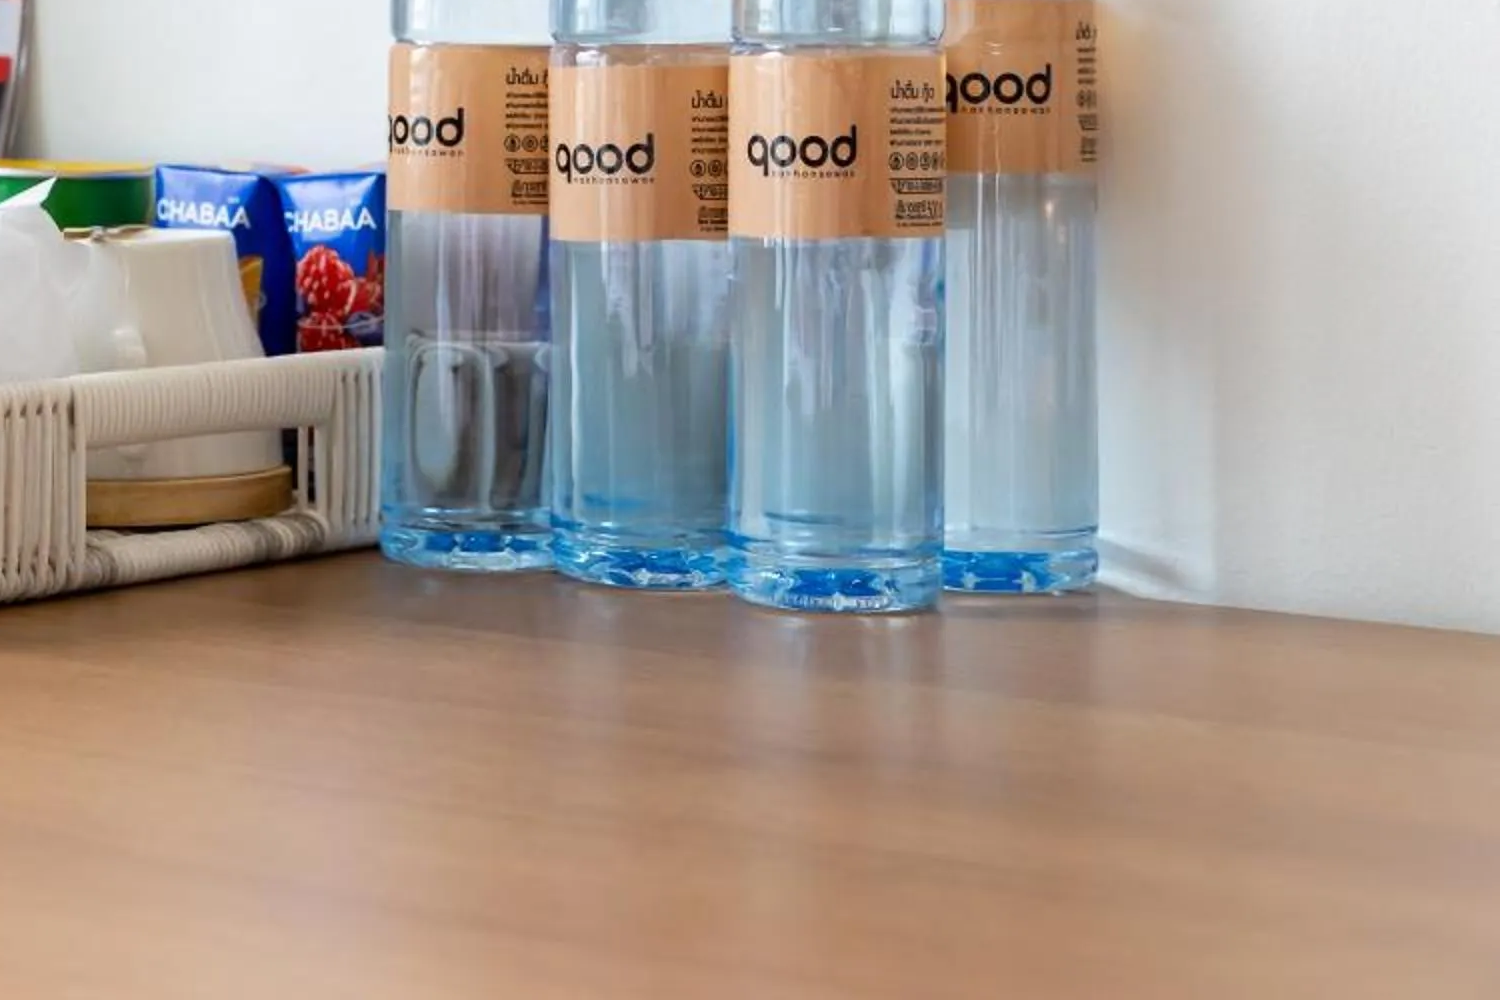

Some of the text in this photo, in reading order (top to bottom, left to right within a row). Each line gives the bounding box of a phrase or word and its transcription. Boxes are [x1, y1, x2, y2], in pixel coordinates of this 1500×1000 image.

[388, 107, 465, 152] ood
[747, 124, 858, 177] qood
[555, 132, 655, 184] qood
